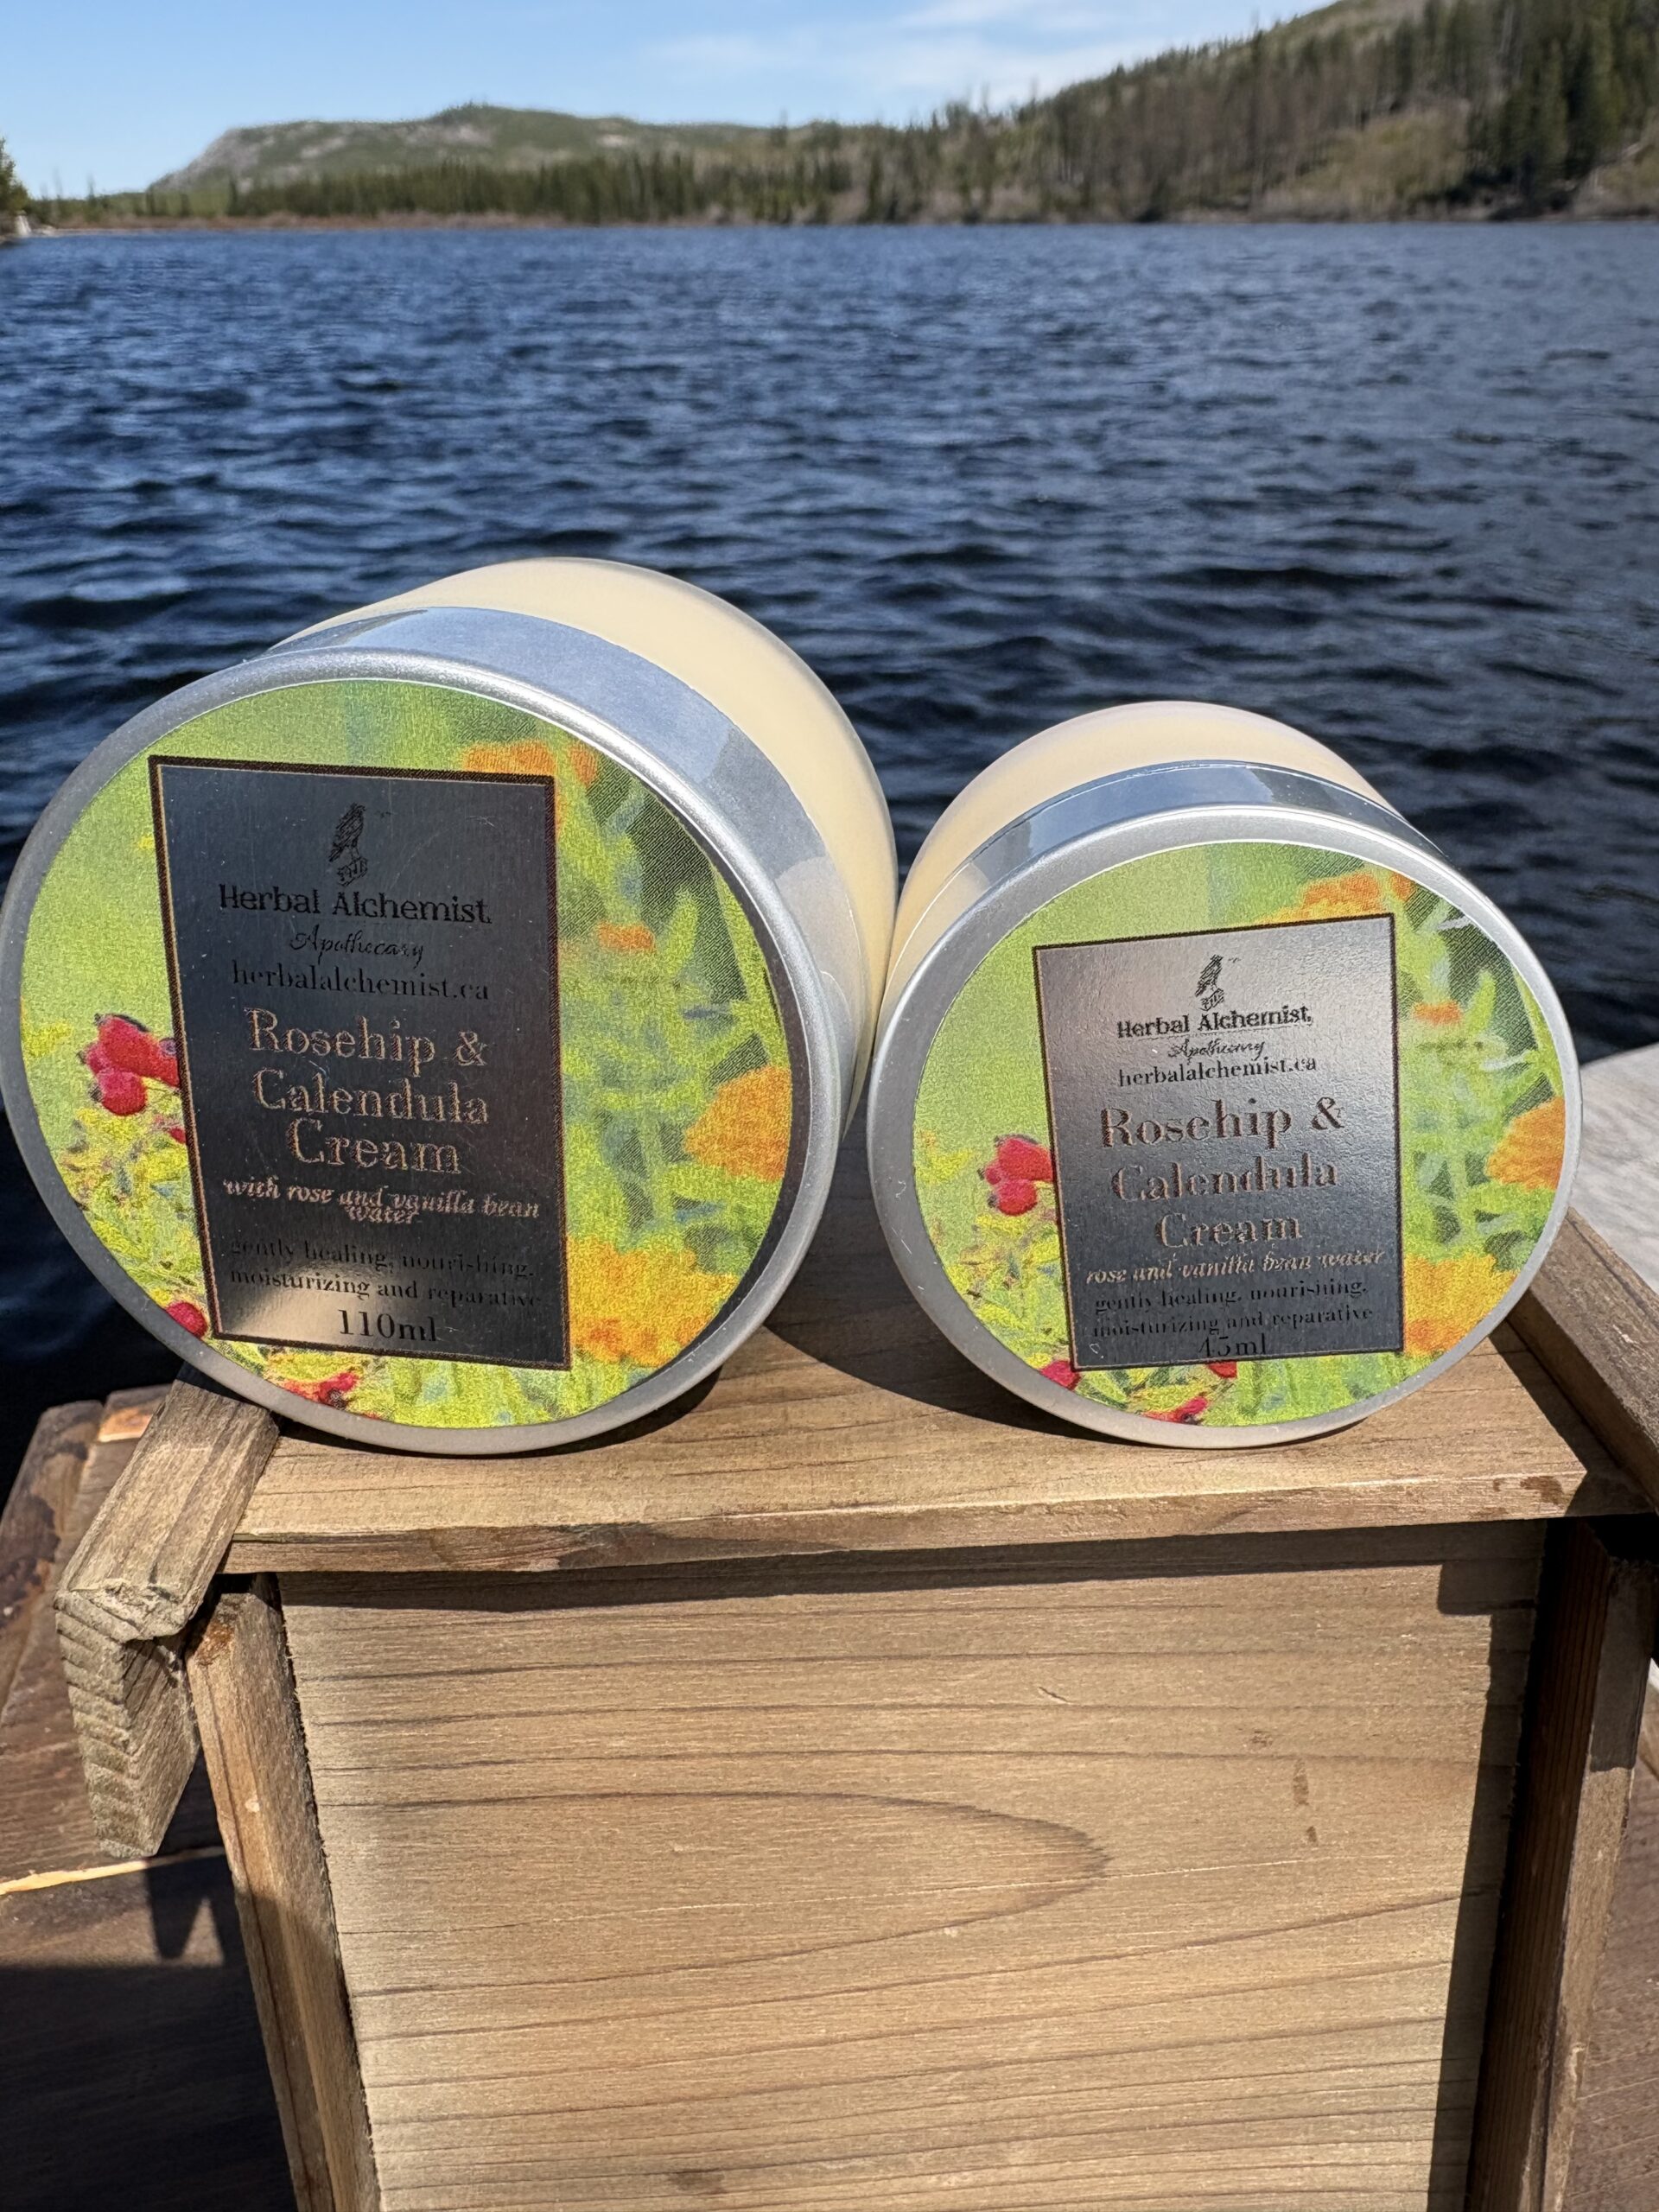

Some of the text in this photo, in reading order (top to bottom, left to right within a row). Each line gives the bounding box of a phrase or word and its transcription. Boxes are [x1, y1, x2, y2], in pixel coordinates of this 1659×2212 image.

[219, 883, 492, 925] Herbal Alchemist
[289, 925, 424, 969] Apothecary
[232, 960, 490, 1000] herbalalchemist.ca
[245, 1006, 488, 1077] Rosehip &
[1116, 1014, 1190, 1038] Herbal
[1119, 1056, 1317, 1087] herbalalchemist.ca
[251, 1067, 489, 1123] Calendula
[1100, 1096, 1345, 1149] Rosehip &
[286, 1117, 462, 1174] Cream
[1111, 1152, 1339, 1202] Calendula
[223, 1176, 541, 1219] with rose and vanilla bean
[229, 1240, 294, 1258] gently
[1155, 1212, 1303, 1249] Cream
[229, 1269, 372, 1300] moisturizing
[376, 1281, 419, 1300] and
[1085, 1249, 1384, 1285] rose and vanilla bean water
[1094, 1287, 1154, 1316] gently
[336, 1309, 438, 1344] 110ml
[1093, 1306, 1374, 1338] moisturizing and reparative
